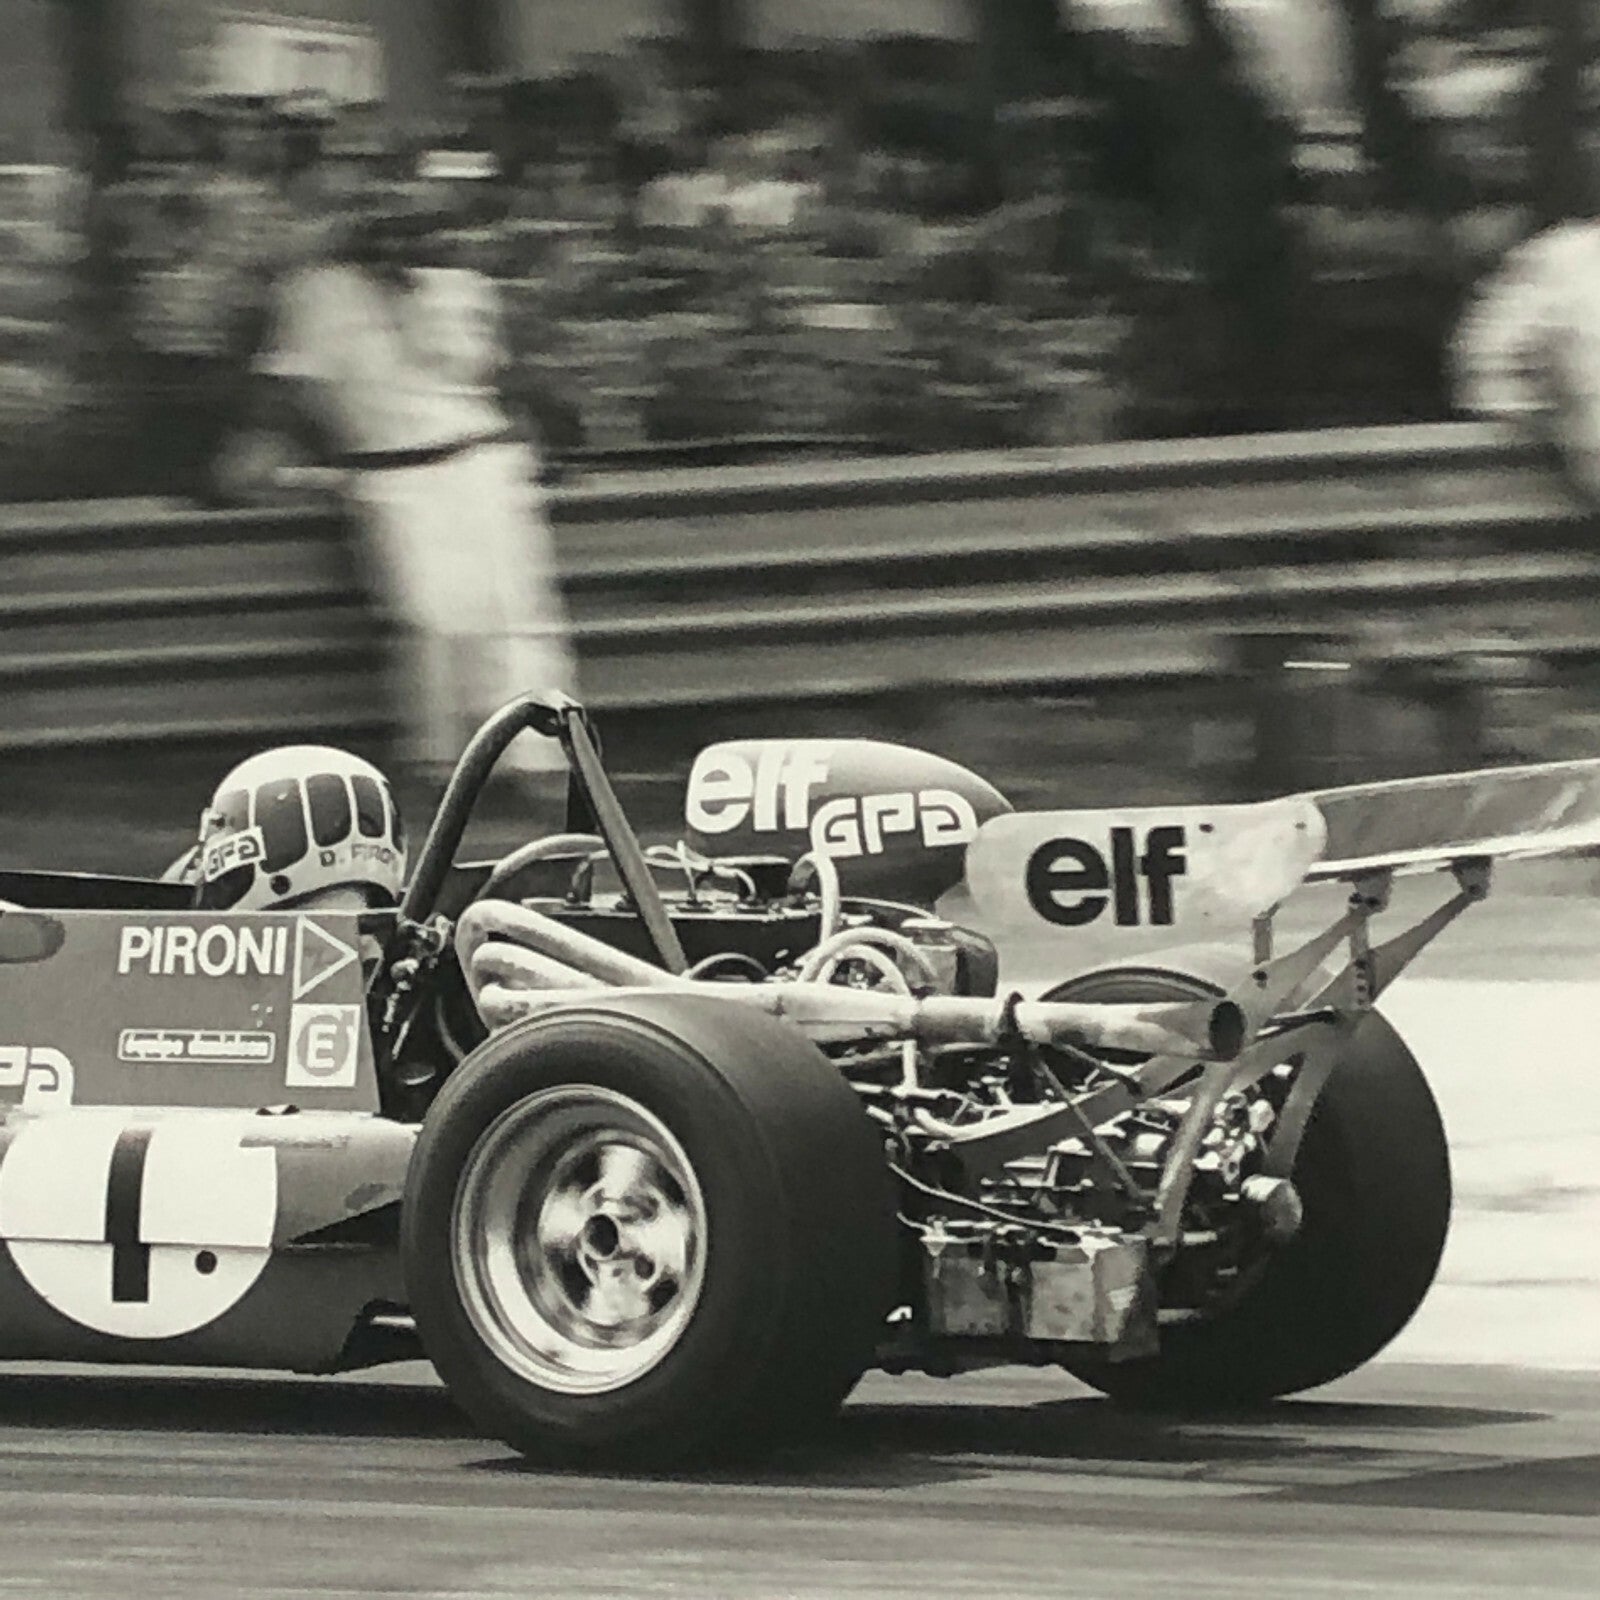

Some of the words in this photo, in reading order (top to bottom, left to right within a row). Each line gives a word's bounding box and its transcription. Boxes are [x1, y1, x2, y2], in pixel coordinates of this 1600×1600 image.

[686, 748, 832, 834] elf
[1025, 825, 1187, 926] elf
[118, 924, 288, 976] PIRONI
[306, 1023, 338, 1069] E
